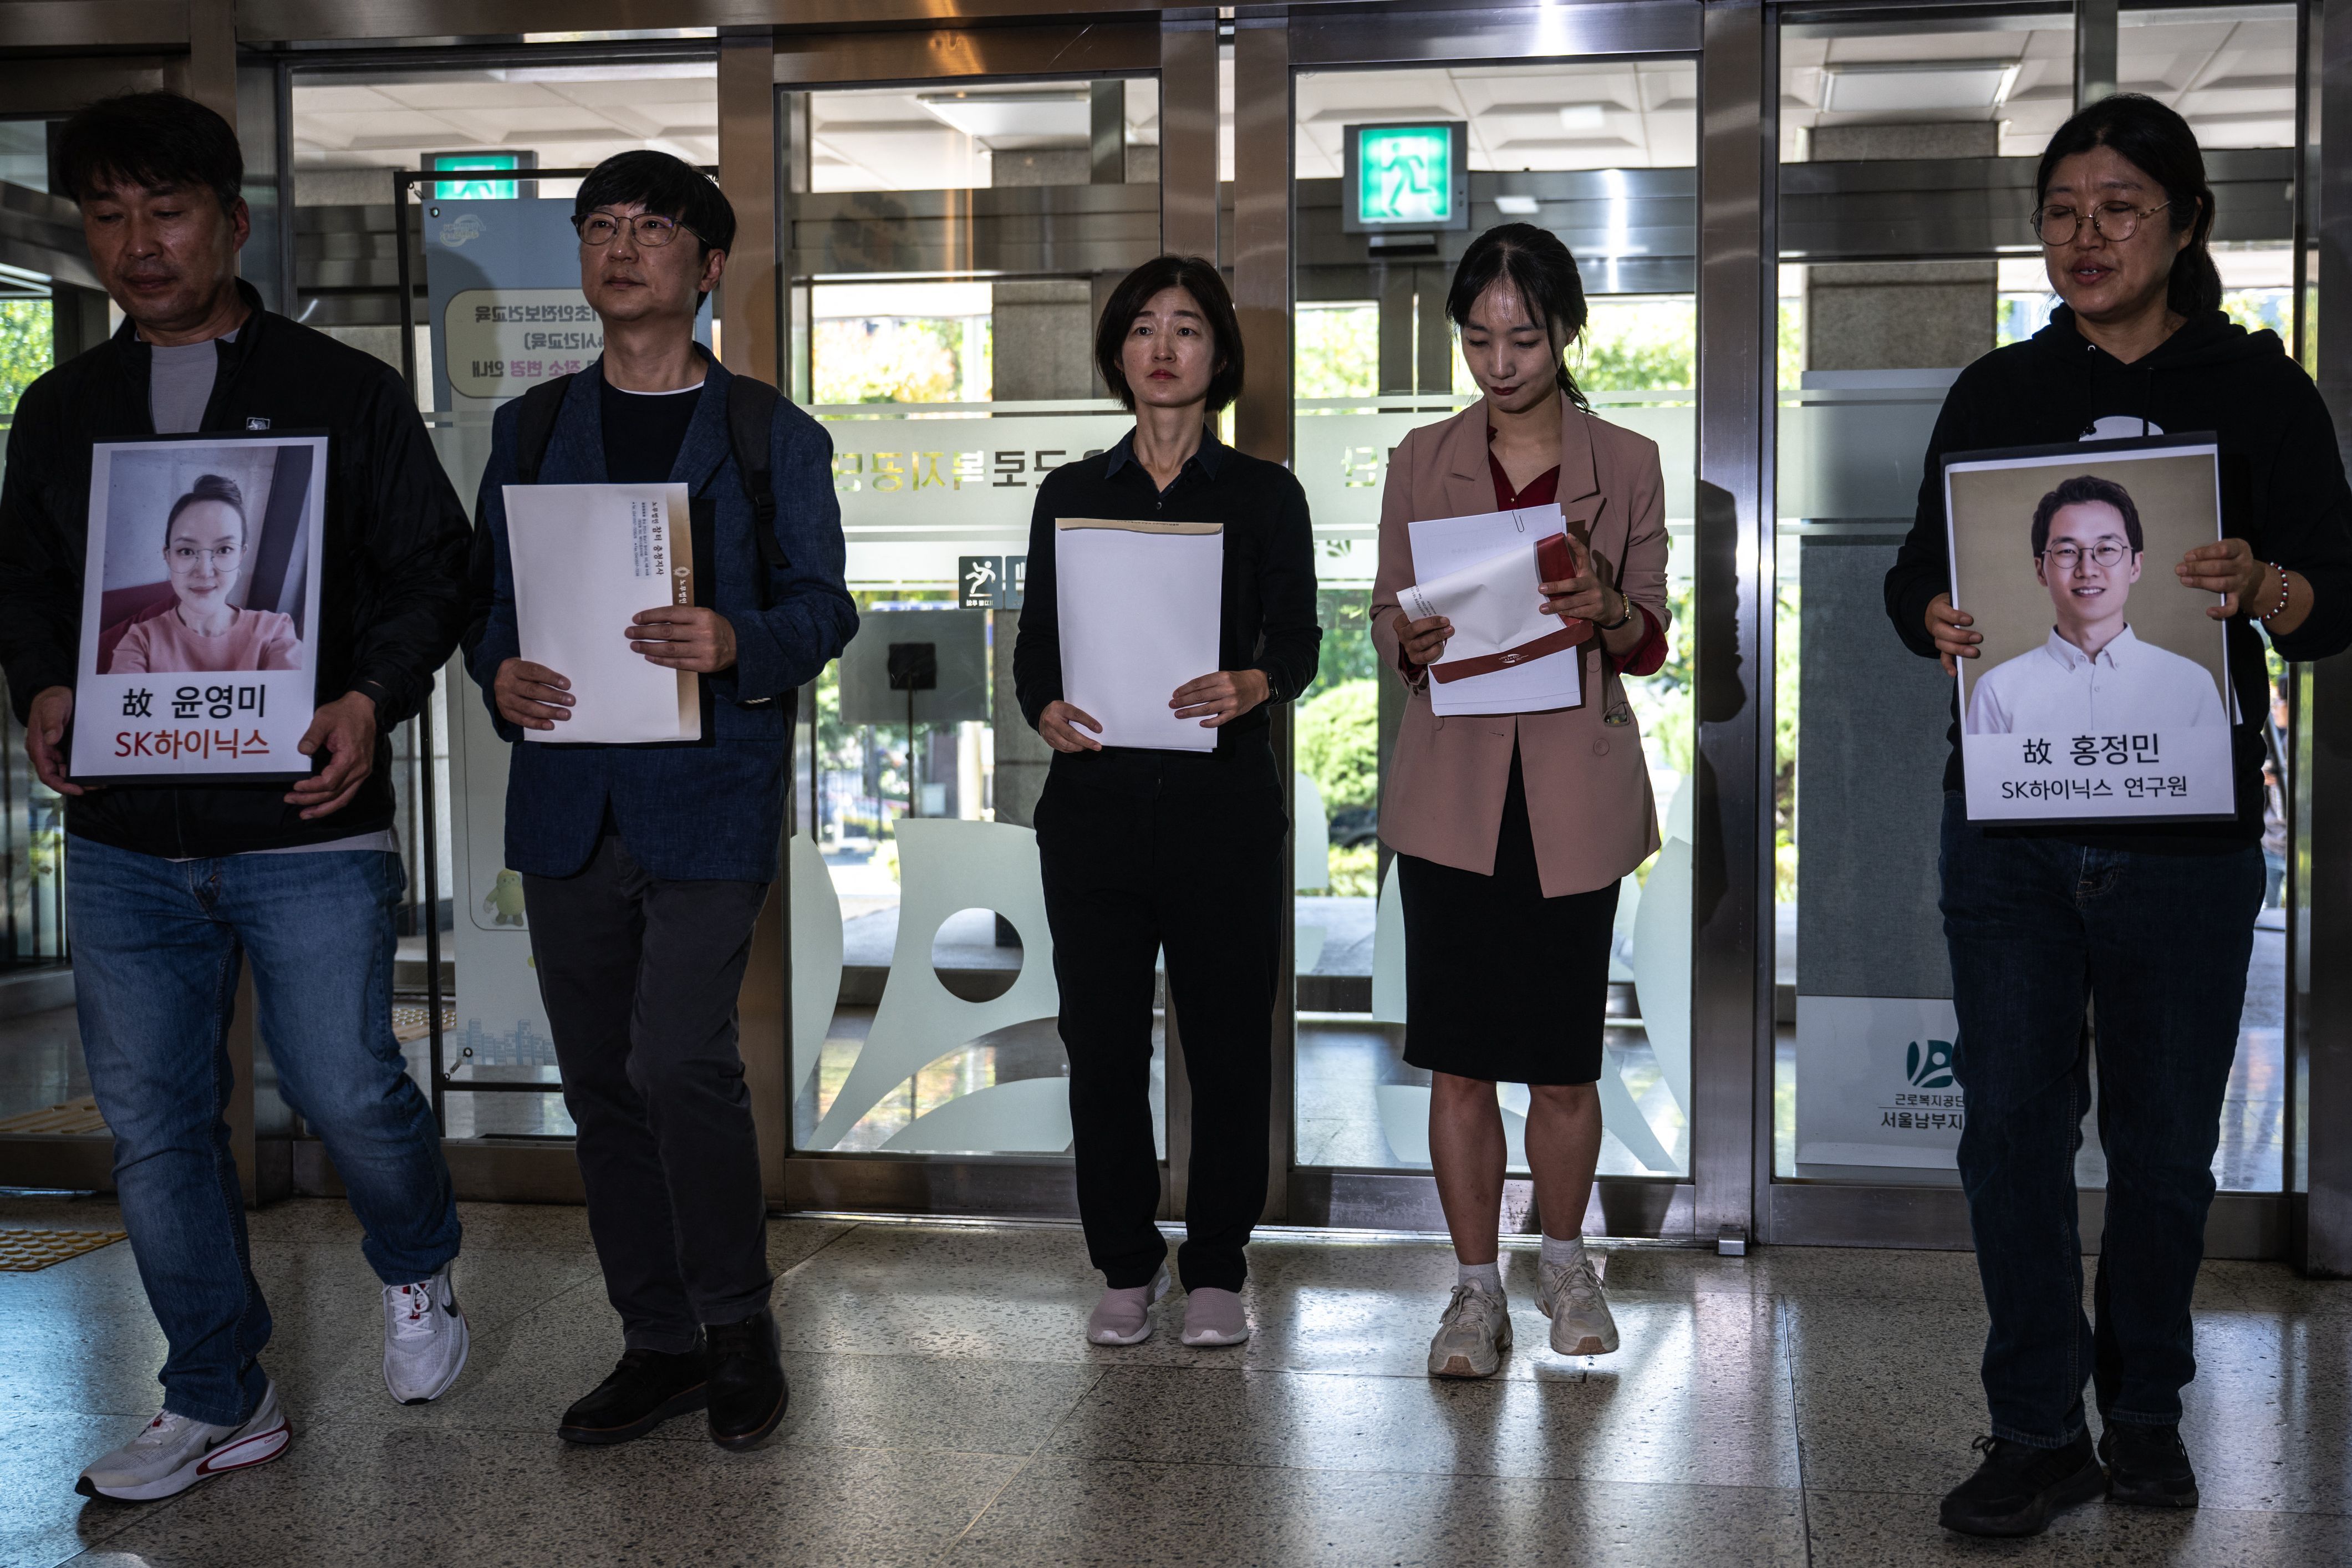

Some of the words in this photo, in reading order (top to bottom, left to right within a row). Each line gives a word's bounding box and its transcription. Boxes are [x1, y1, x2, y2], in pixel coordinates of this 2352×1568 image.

[651, 501, 660, 524] 노무법인
[651, 526, 663, 541] 참터
[653, 544, 665, 576] 충청지사
[678, 579, 688, 604] 노무법인
[122, 688, 154, 718] 故
[171, 684, 266, 719] 윤영미
[114, 728, 270, 760] SK하이닉스
[2022, 738, 2053, 765] 故
[2069, 732, 2160, 766] 홍정민
[2001, 778, 2114, 801] SK하이닉스
[2124, 775, 2187, 798] 연구원
[1895, 1093, 1964, 1107] 근로복지공단
